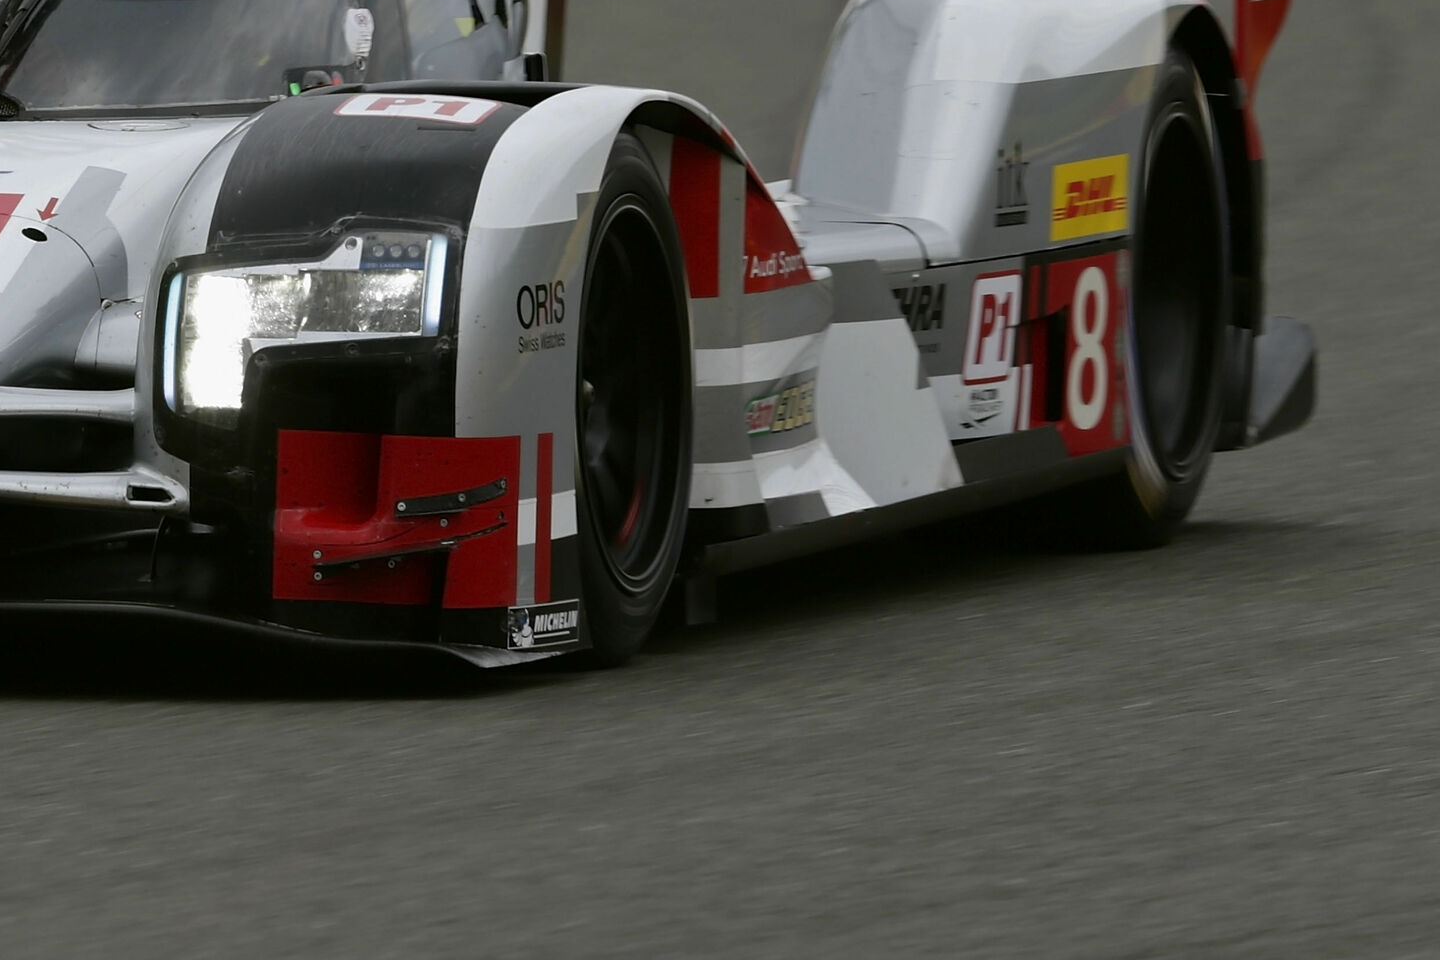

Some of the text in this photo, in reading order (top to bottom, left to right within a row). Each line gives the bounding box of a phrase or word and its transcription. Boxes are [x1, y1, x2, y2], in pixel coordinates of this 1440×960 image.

[364, 96, 470, 117] P1
[1067, 175, 1115, 219] DHL
[517, 280, 565, 329] ORIS
[973, 291, 1013, 365] P1
[1068, 266, 1109, 430] 8
[534, 610, 578, 633] MICHELIN
